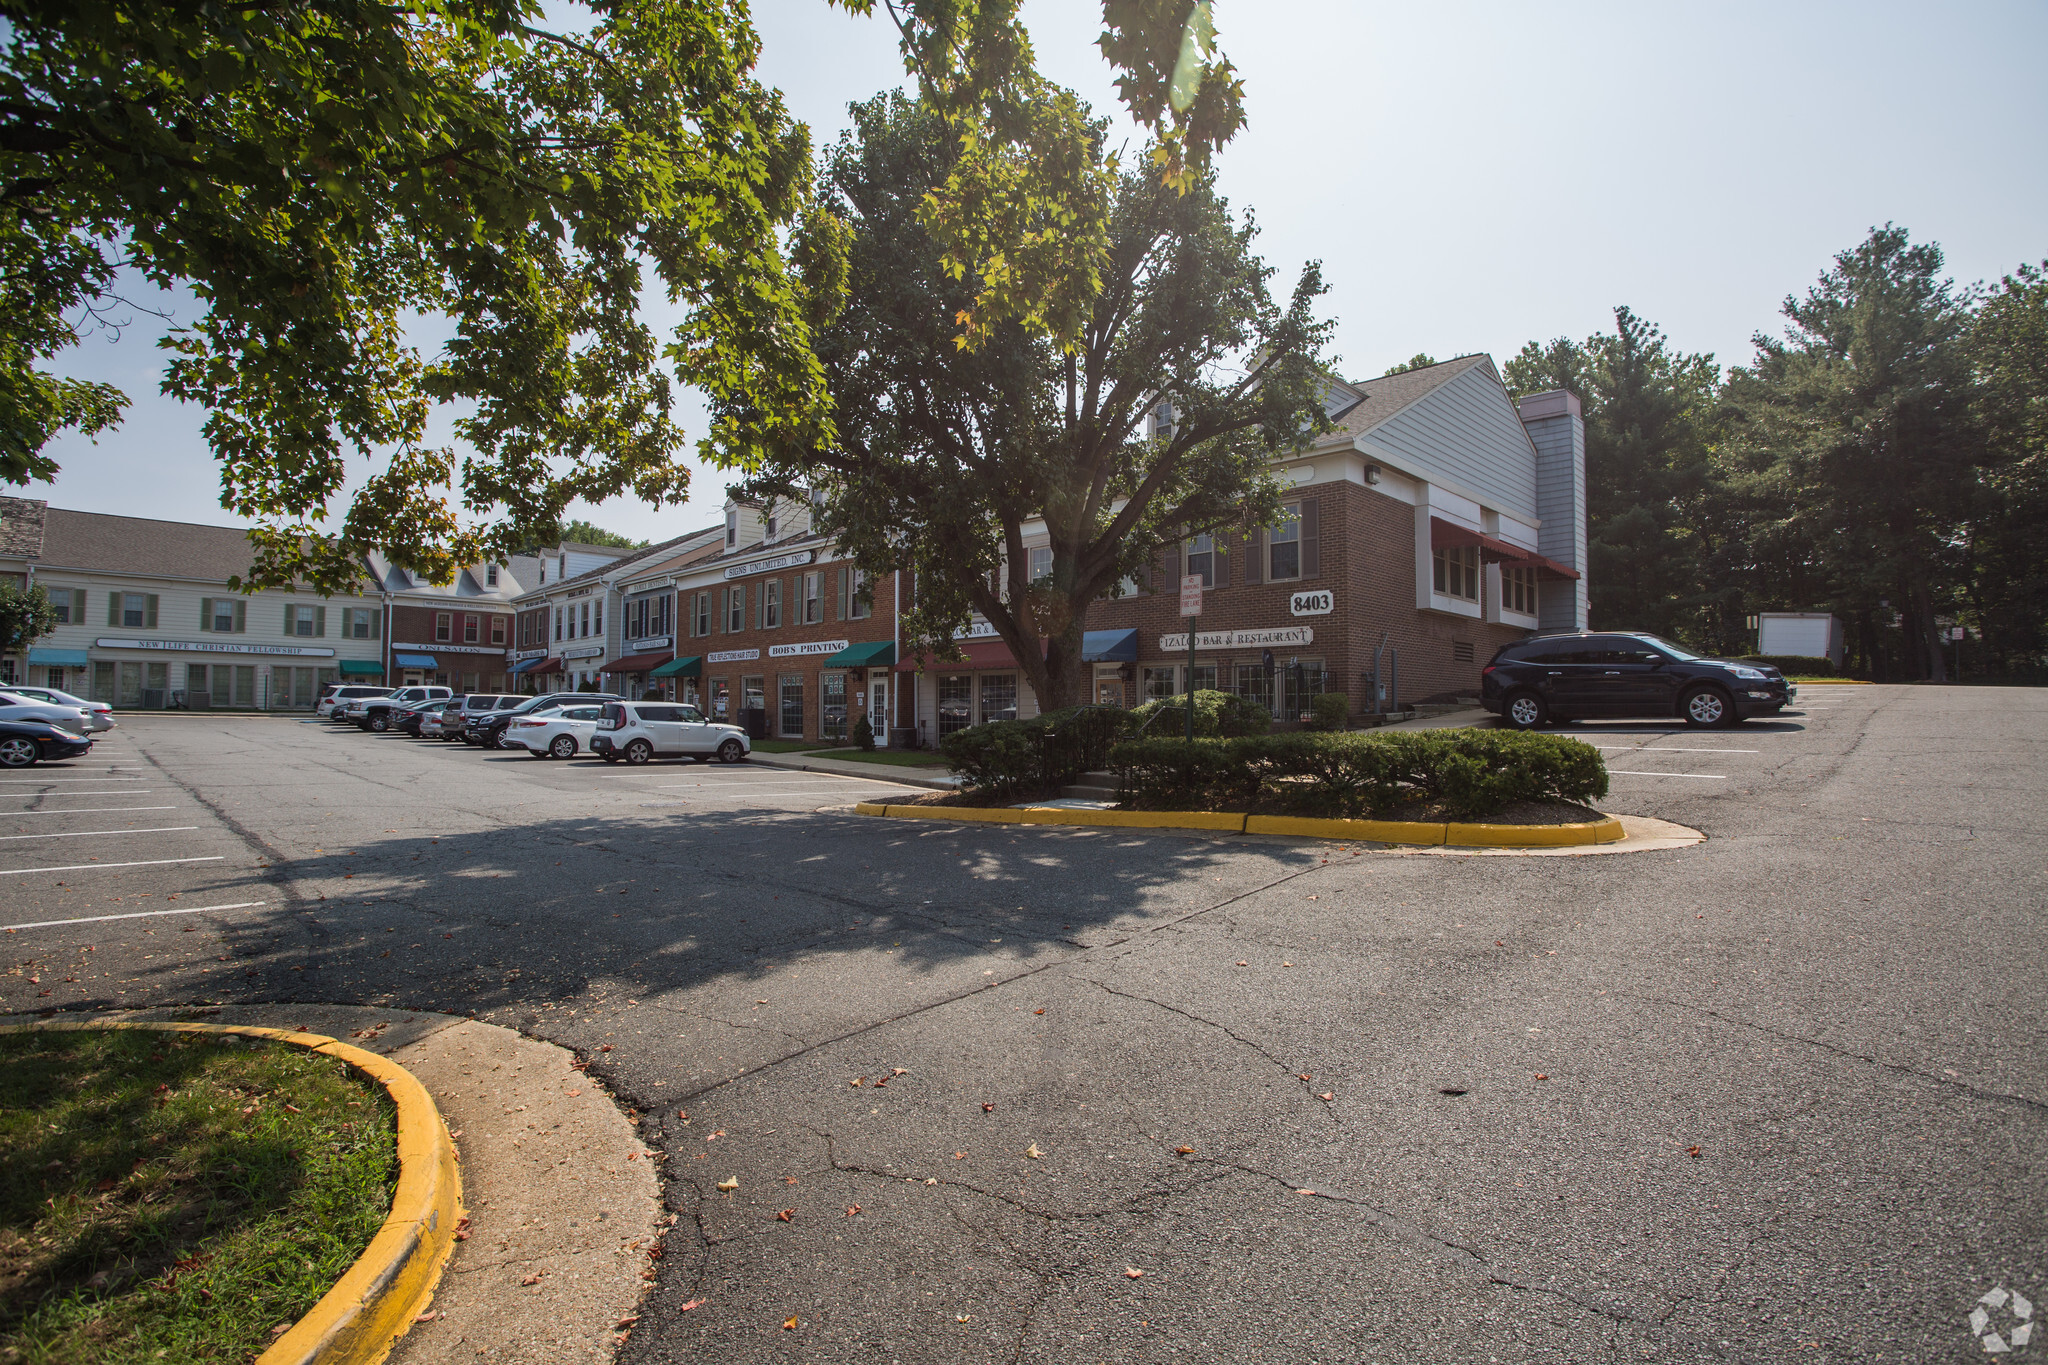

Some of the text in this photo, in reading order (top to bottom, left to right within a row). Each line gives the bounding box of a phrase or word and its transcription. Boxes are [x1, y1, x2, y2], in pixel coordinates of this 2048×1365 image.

[729, 554, 805, 577] SIGNS UNLIMITED, INC.
[1294, 594, 1329, 612] 8403
[1203, 635, 1222, 645] BAR
[1226, 634, 1233, 645] &
[1237, 630, 1307, 644] RESTAURANT
[138, 640, 303, 655] NEW LIFE CHRISTIAN FELLOWSHIP
[445, 645, 481, 653] SALON
[800, 642, 845, 653] PRINTING
